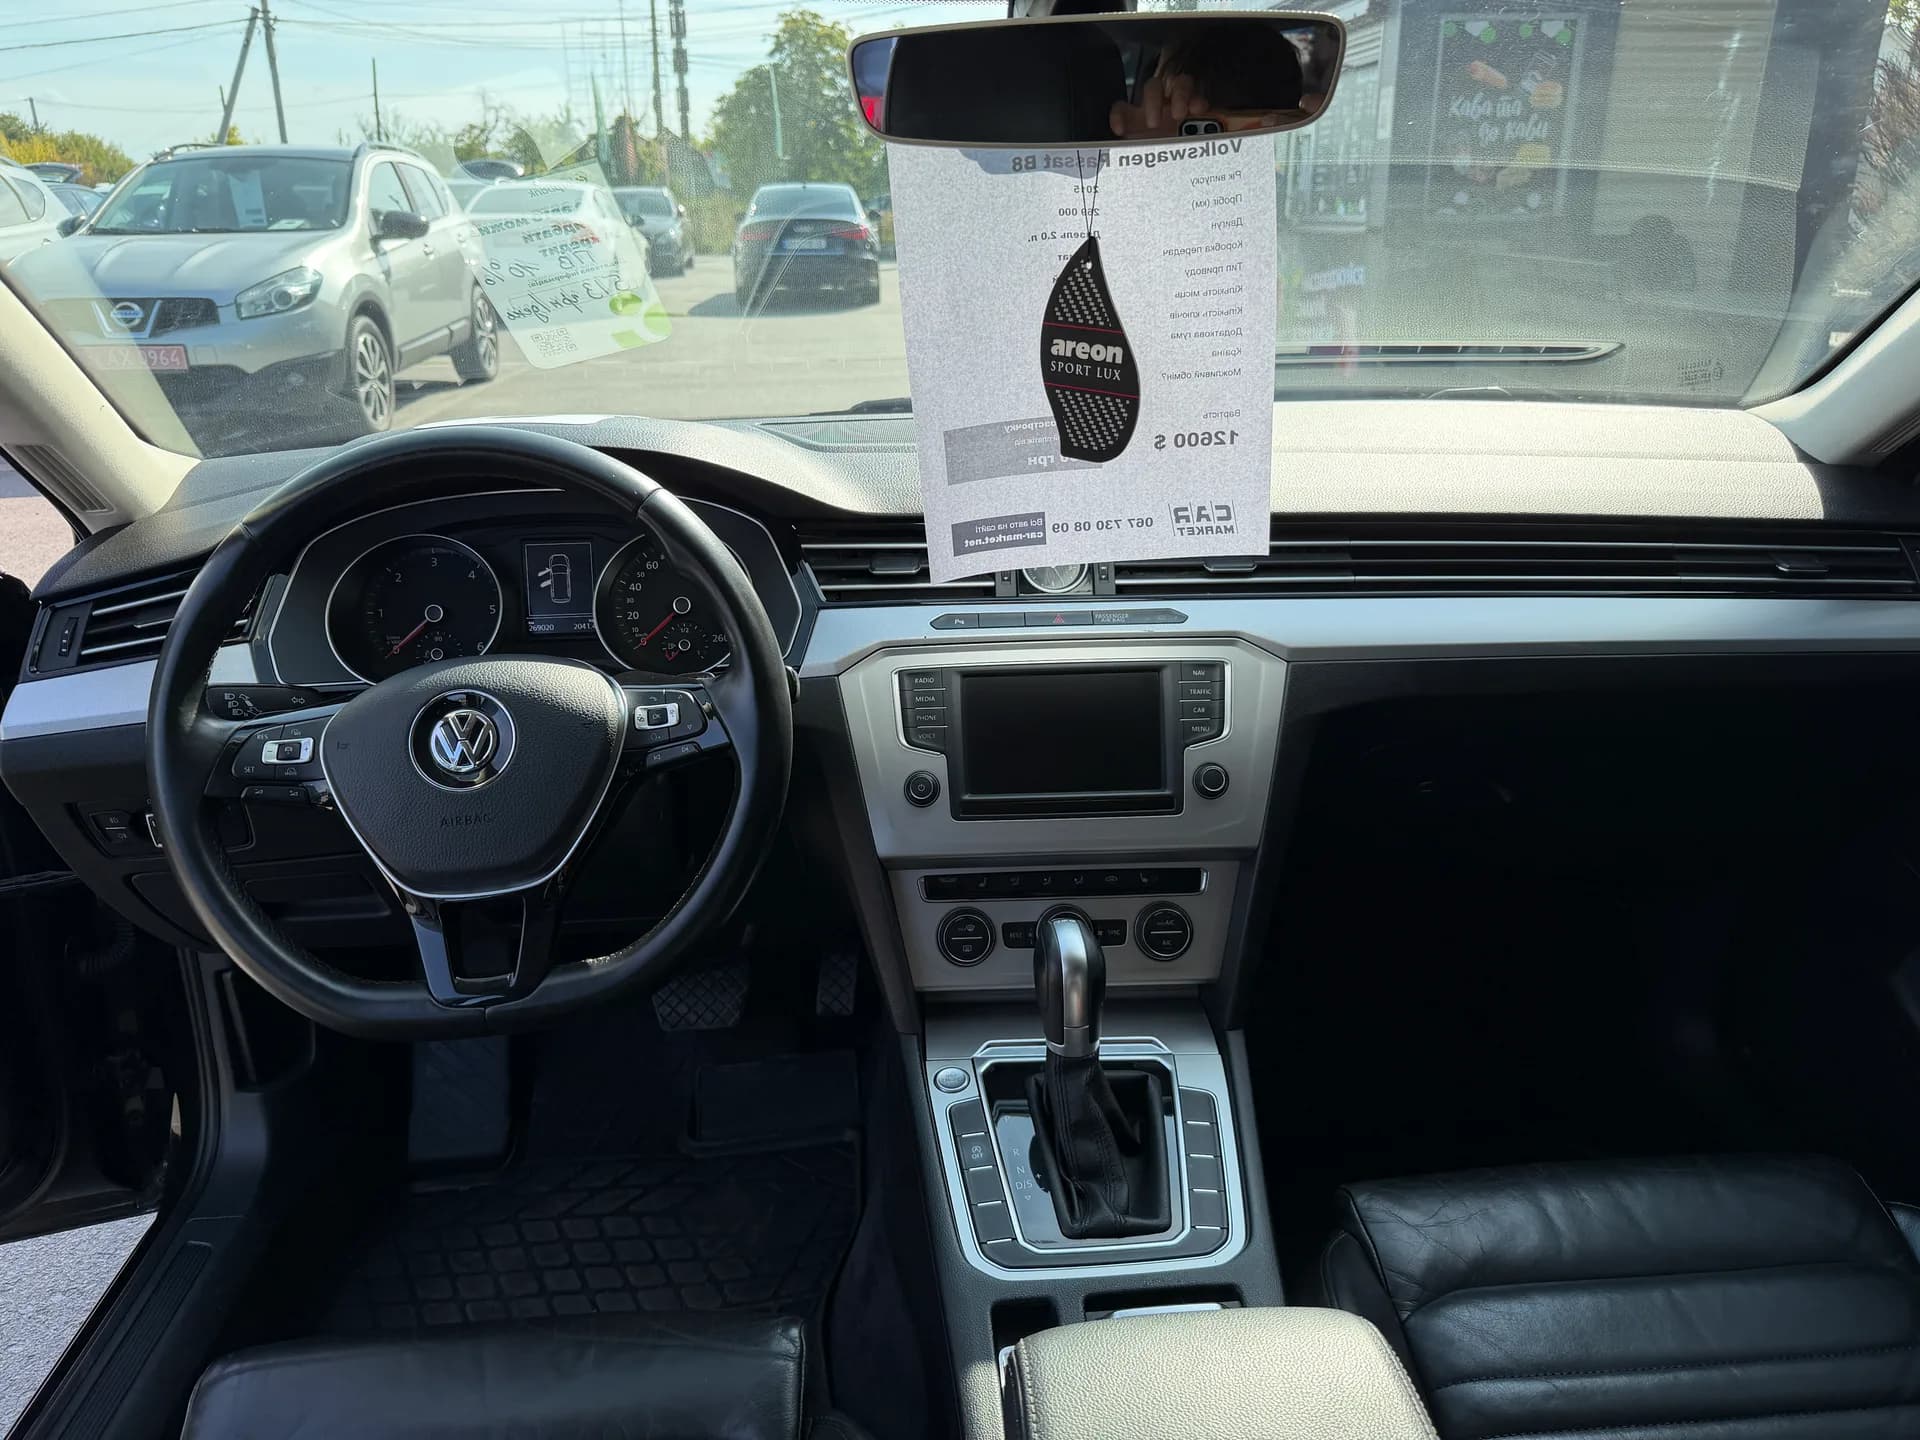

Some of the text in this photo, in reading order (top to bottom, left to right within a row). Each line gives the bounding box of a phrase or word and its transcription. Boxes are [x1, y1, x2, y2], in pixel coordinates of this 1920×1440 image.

[1050, 337, 1124, 365] areon
[1050, 360, 1122, 382] SPORT LUX
[646, 560, 659, 570] 60
[628, 582, 642, 592] 40
[627, 611, 640, 620] 20
[439, 813, 494, 828] AIRBAG
[1016, 1166, 1025, 1175] N
